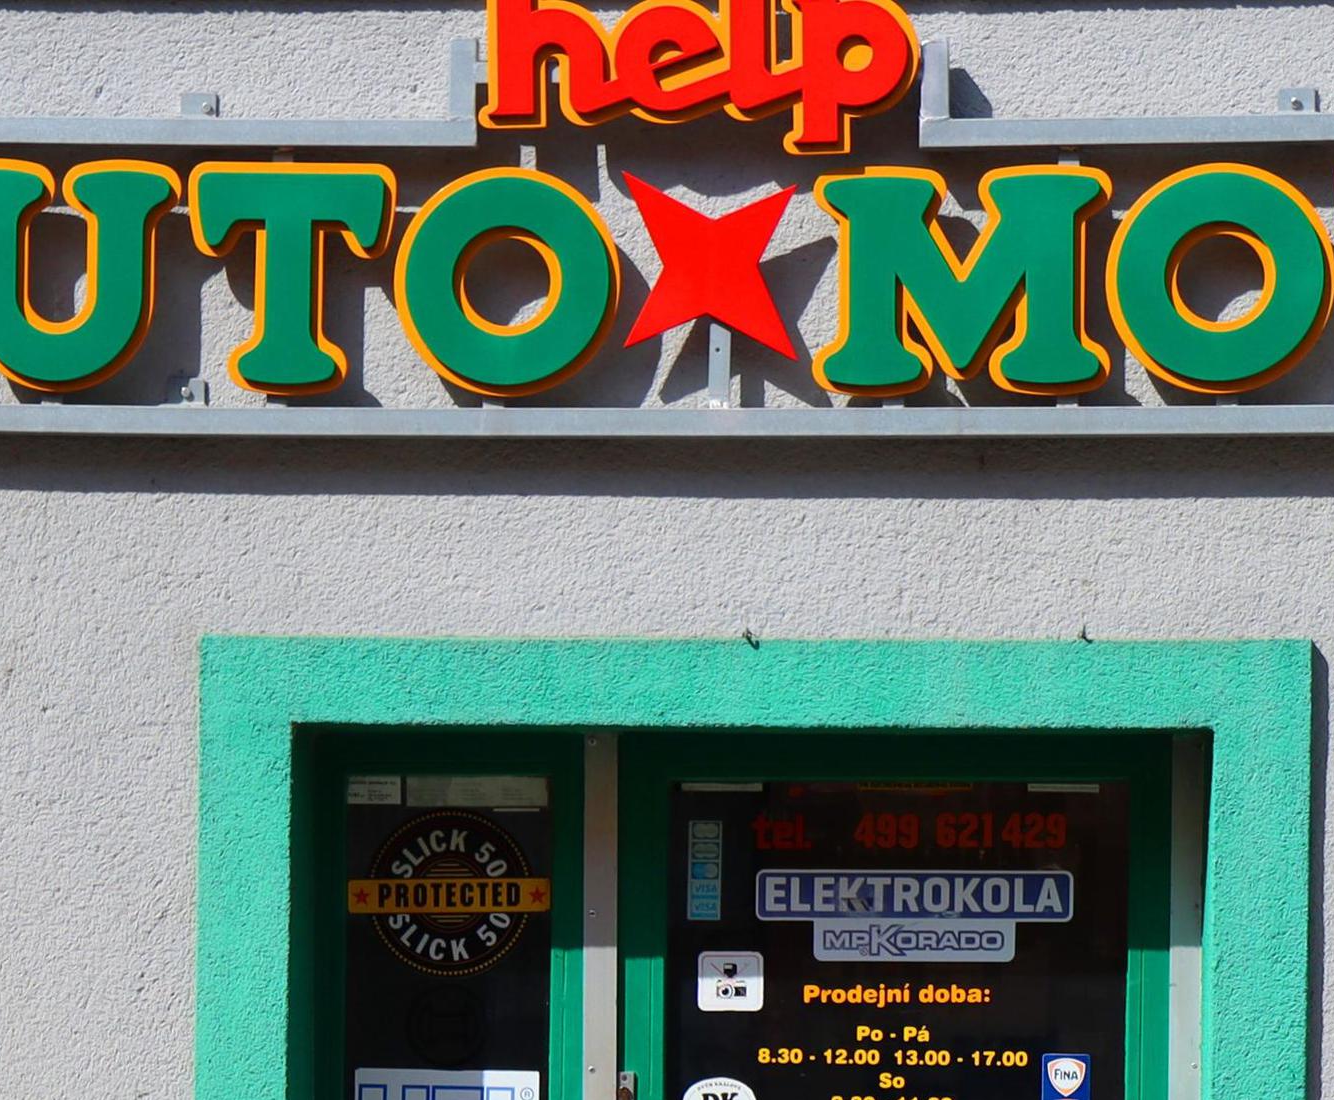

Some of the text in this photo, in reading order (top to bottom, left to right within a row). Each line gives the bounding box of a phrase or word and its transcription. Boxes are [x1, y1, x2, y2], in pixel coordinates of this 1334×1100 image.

[475, 0, 921, 155] help
[751, 812, 1068, 850] tel. 499 621 429
[391, 828, 509, 879] SLICK 50
[377, 881, 522, 909] PROTECTED
[764, 876, 1064, 914] ELEKTROKOLA
[387, 913, 512, 962] SLICK 50
[803, 983, 991, 1008] Prodejní doba:
[856, 1025, 884, 1042] Po
[903, 1025, 930, 1043] Pá
[757, 1048, 804, 1065] 8.30
[823, 1048, 880, 1066] 12.00
[893, 1049, 951, 1067] 13.00
[971, 1051, 1029, 1068] 17.00
[878, 1073, 906, 1090] So
[1053, 1068, 1079, 1081] FINA
